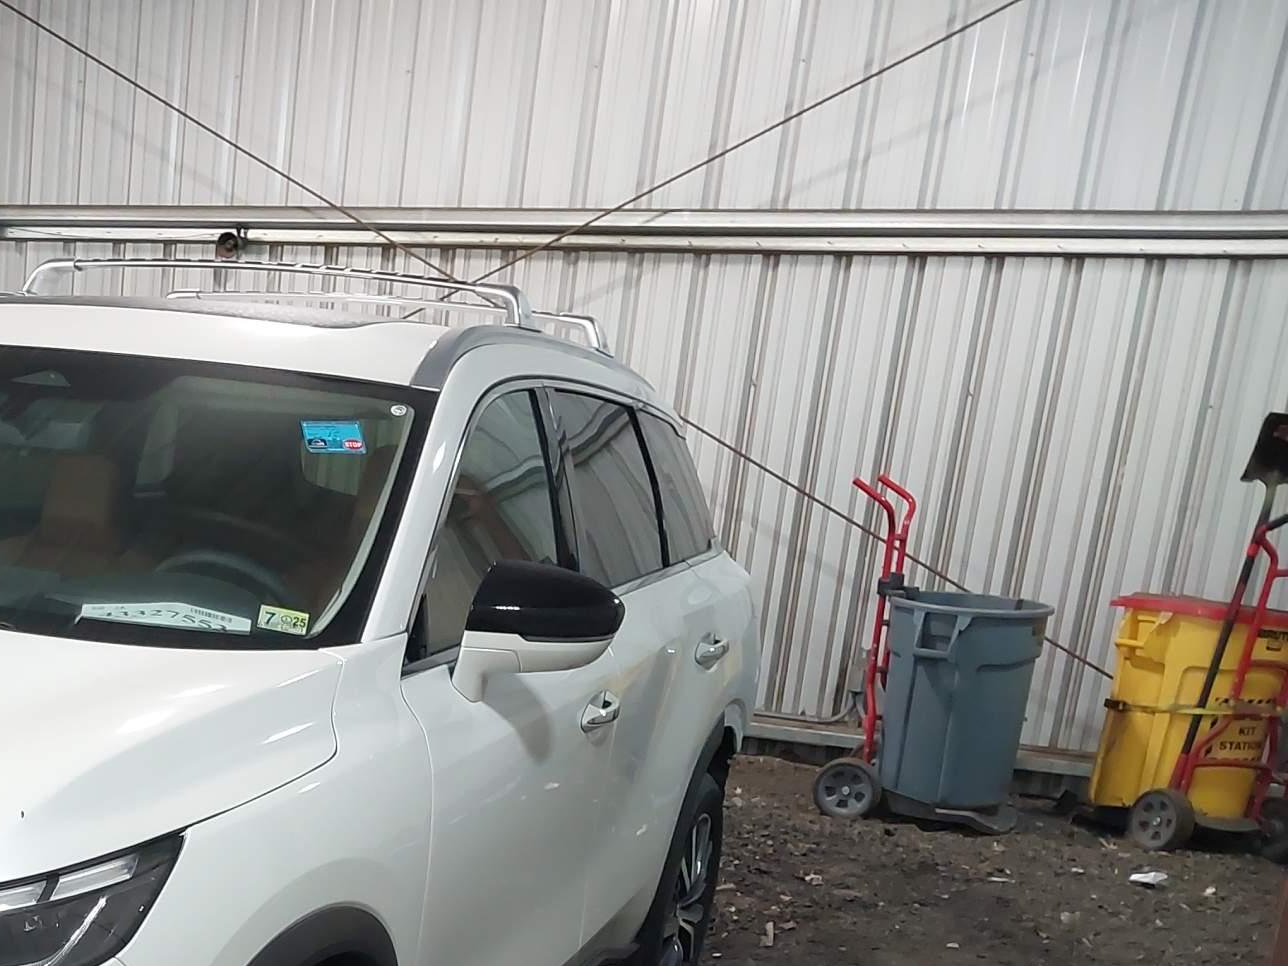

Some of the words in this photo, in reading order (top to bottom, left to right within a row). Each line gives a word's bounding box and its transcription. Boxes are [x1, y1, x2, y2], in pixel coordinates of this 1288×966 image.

[265, 611, 276, 625] 7
[292, 616, 307, 629] 25
[1238, 726, 1256, 737] KIT
[1219, 741, 1262, 751] STATI
